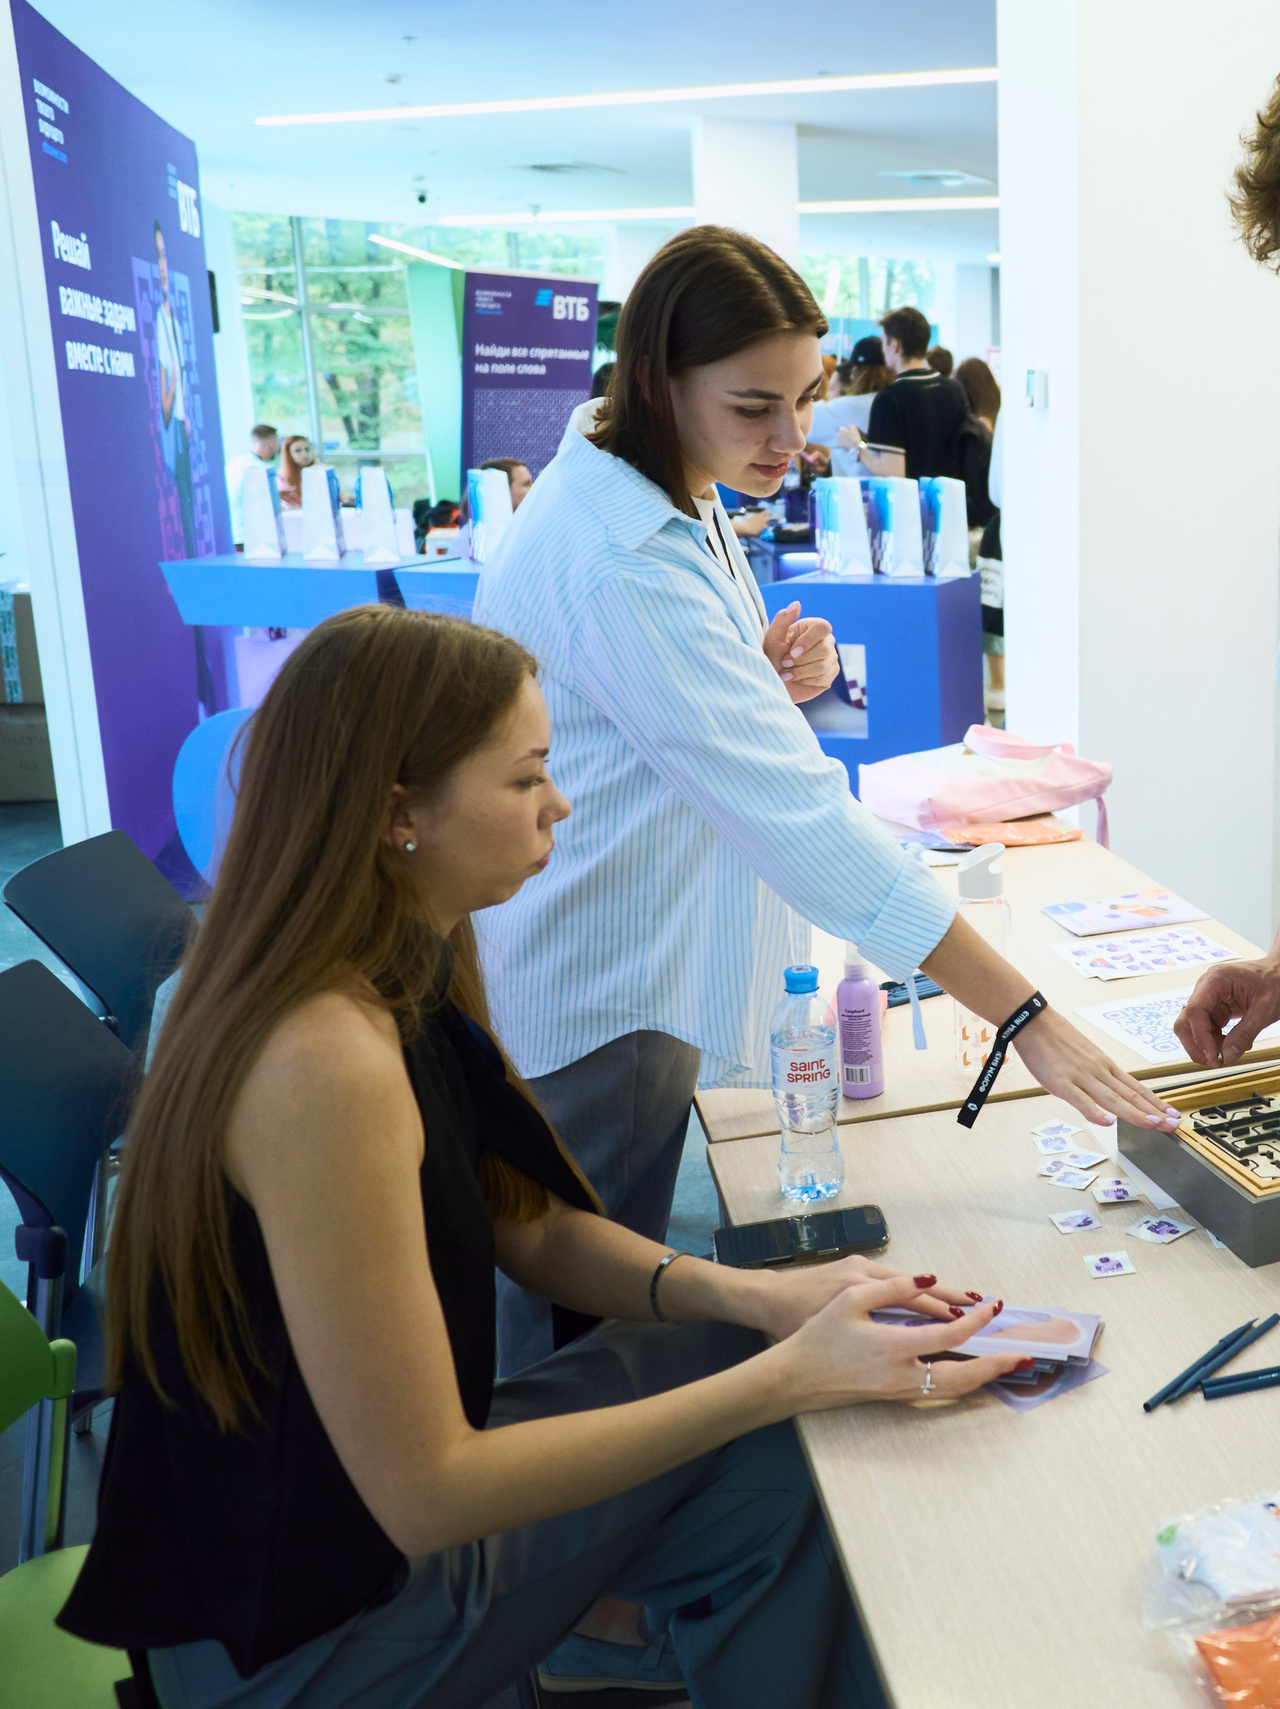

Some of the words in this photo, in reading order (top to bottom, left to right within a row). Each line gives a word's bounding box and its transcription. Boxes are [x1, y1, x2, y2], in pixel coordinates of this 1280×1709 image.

[176, 179, 200, 238] ВТБ
[51, 220, 91, 270] Решай
[59, 285, 103, 324] важные
[102, 299, 137, 335] задачи
[553, 295, 589, 321] ВТБ
[65, 340, 104, 374] вместе
[103, 347, 111, 375] с
[109, 349, 135, 378] нами
[475, 343, 511, 359] Найди
[511, 347, 529, 358] все
[529, 347, 590, 361] спрятанные
[474, 363, 489, 374] на
[490, 363, 516, 375] поле
[516, 364, 546, 375] слова
[979, 1066, 995, 1092] ФОРУМ
